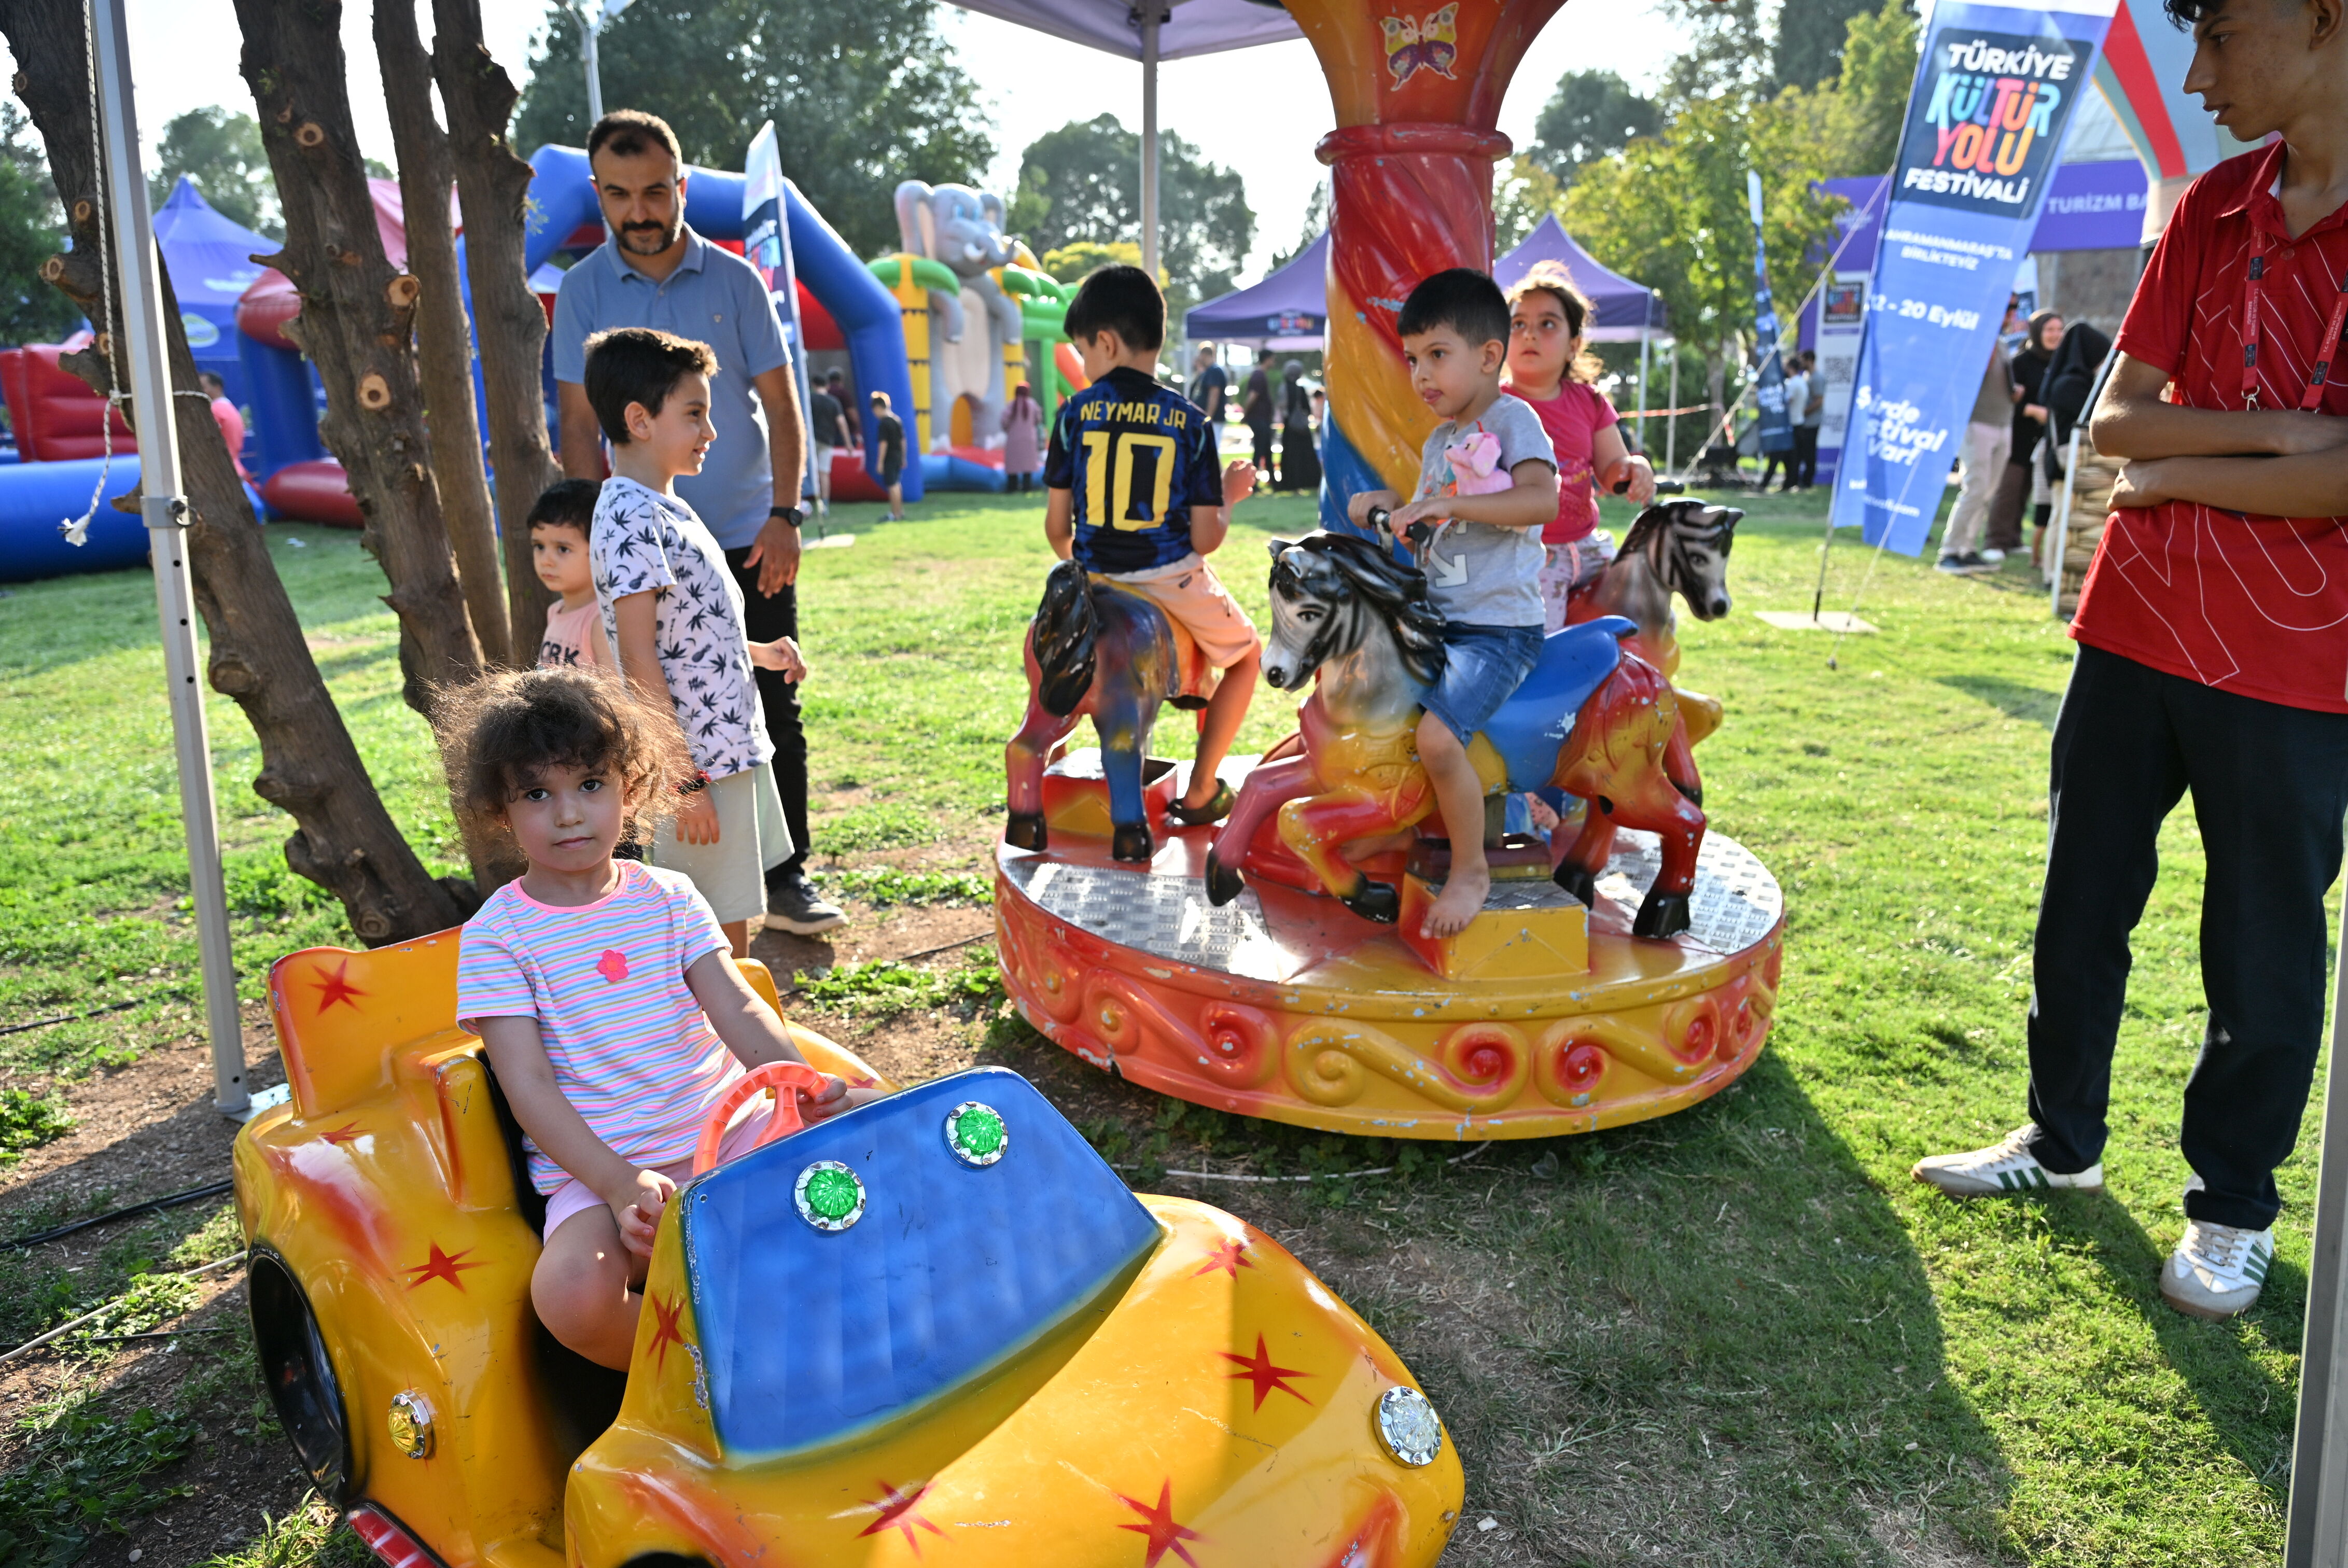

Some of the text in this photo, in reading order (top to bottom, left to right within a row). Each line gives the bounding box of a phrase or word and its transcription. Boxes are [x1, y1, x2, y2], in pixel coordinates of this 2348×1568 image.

[1948, 39, 2075, 80] TÜRKİYE
[1925, 72, 2061, 137] KÜLTÜR
[1933, 121, 2036, 176] YOLU
[1904, 167, 2030, 204] FESTİVALİ
[2048, 192, 2123, 214] TURİZM
[1898, 299, 1927, 319] 20
[1927, 304, 1980, 330] Eylül
[1081, 401, 1186, 430] NEYMAR JR
[1082, 431, 1176, 532] 10
